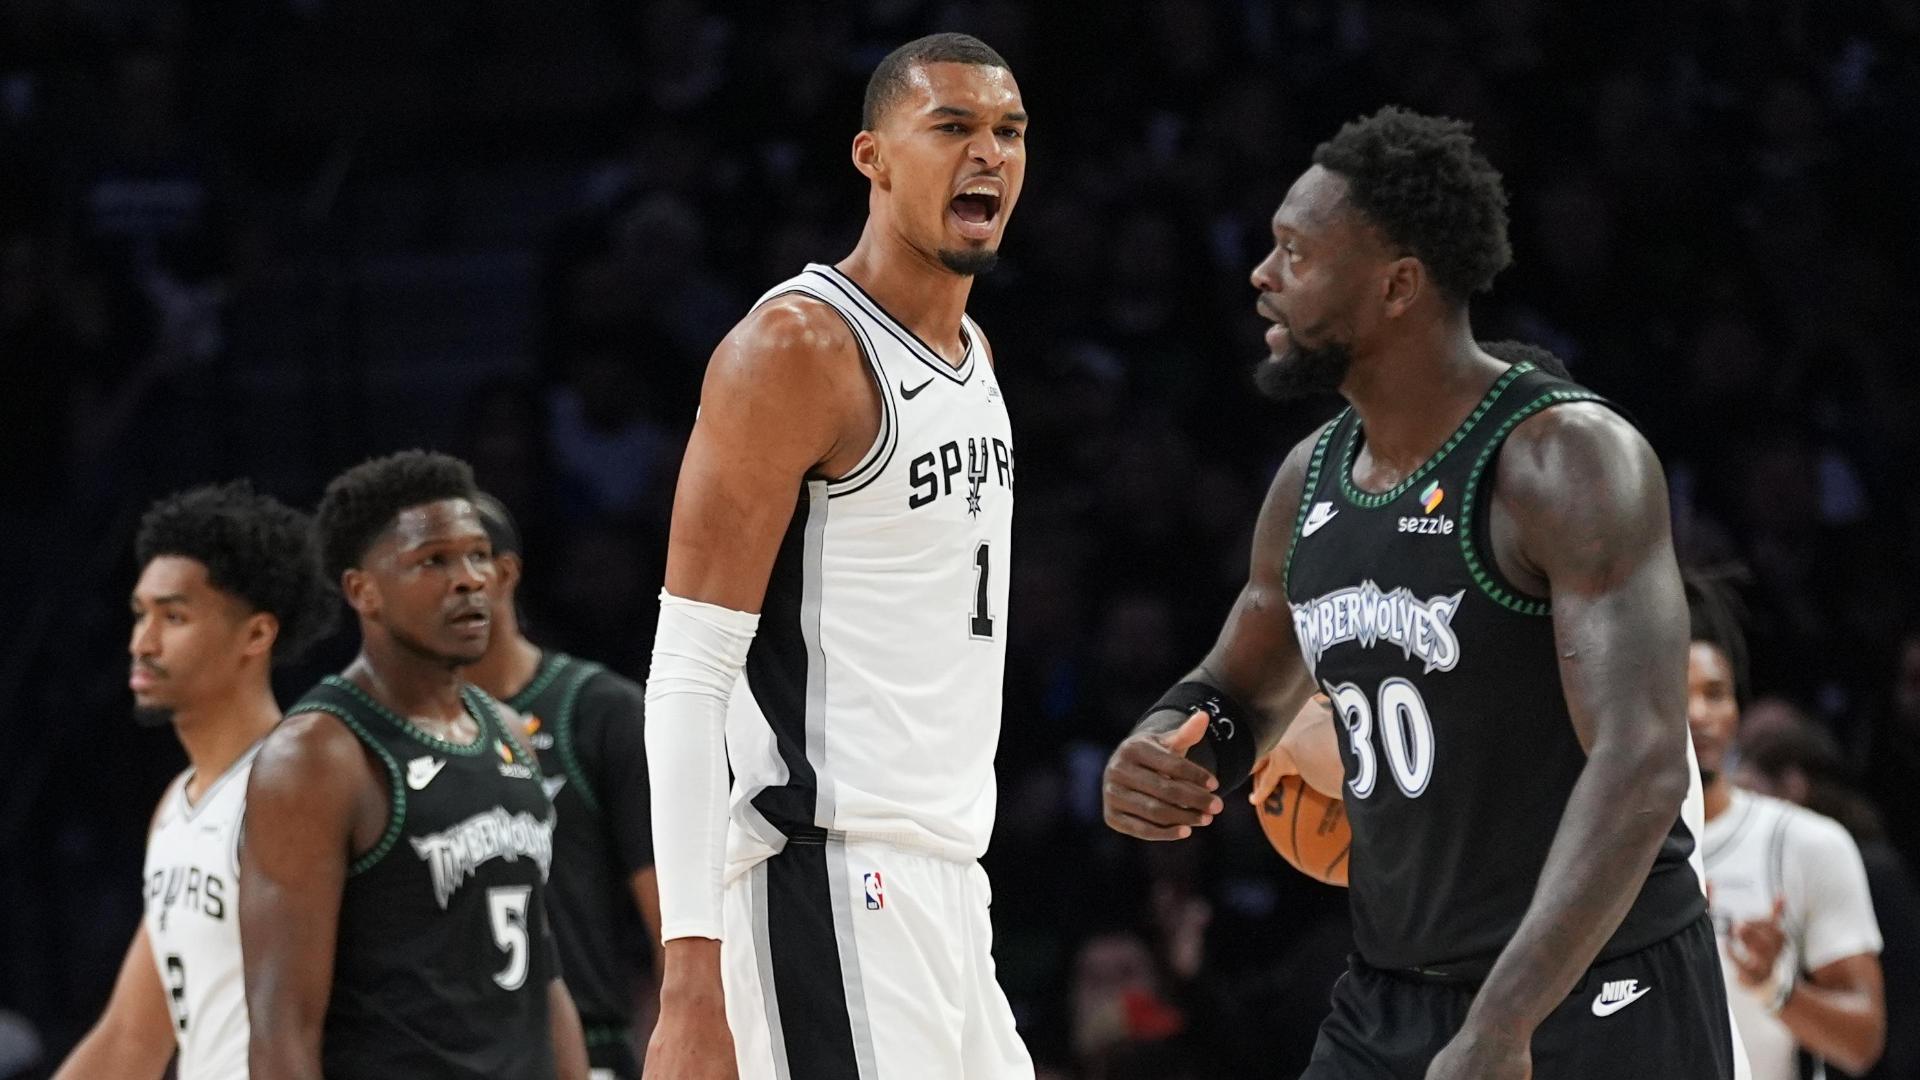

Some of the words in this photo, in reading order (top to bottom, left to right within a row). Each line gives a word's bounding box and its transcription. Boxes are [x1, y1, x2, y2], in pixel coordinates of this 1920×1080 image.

[908, 437, 1014, 519] SPUR
[1397, 514, 1454, 535] sezzle
[967, 539, 996, 643] 1
[1322, 676, 1436, 799] 30
[144, 866, 225, 931] PURS
[486, 886, 532, 991] 5
[1601, 979, 1639, 1002] NIKE
